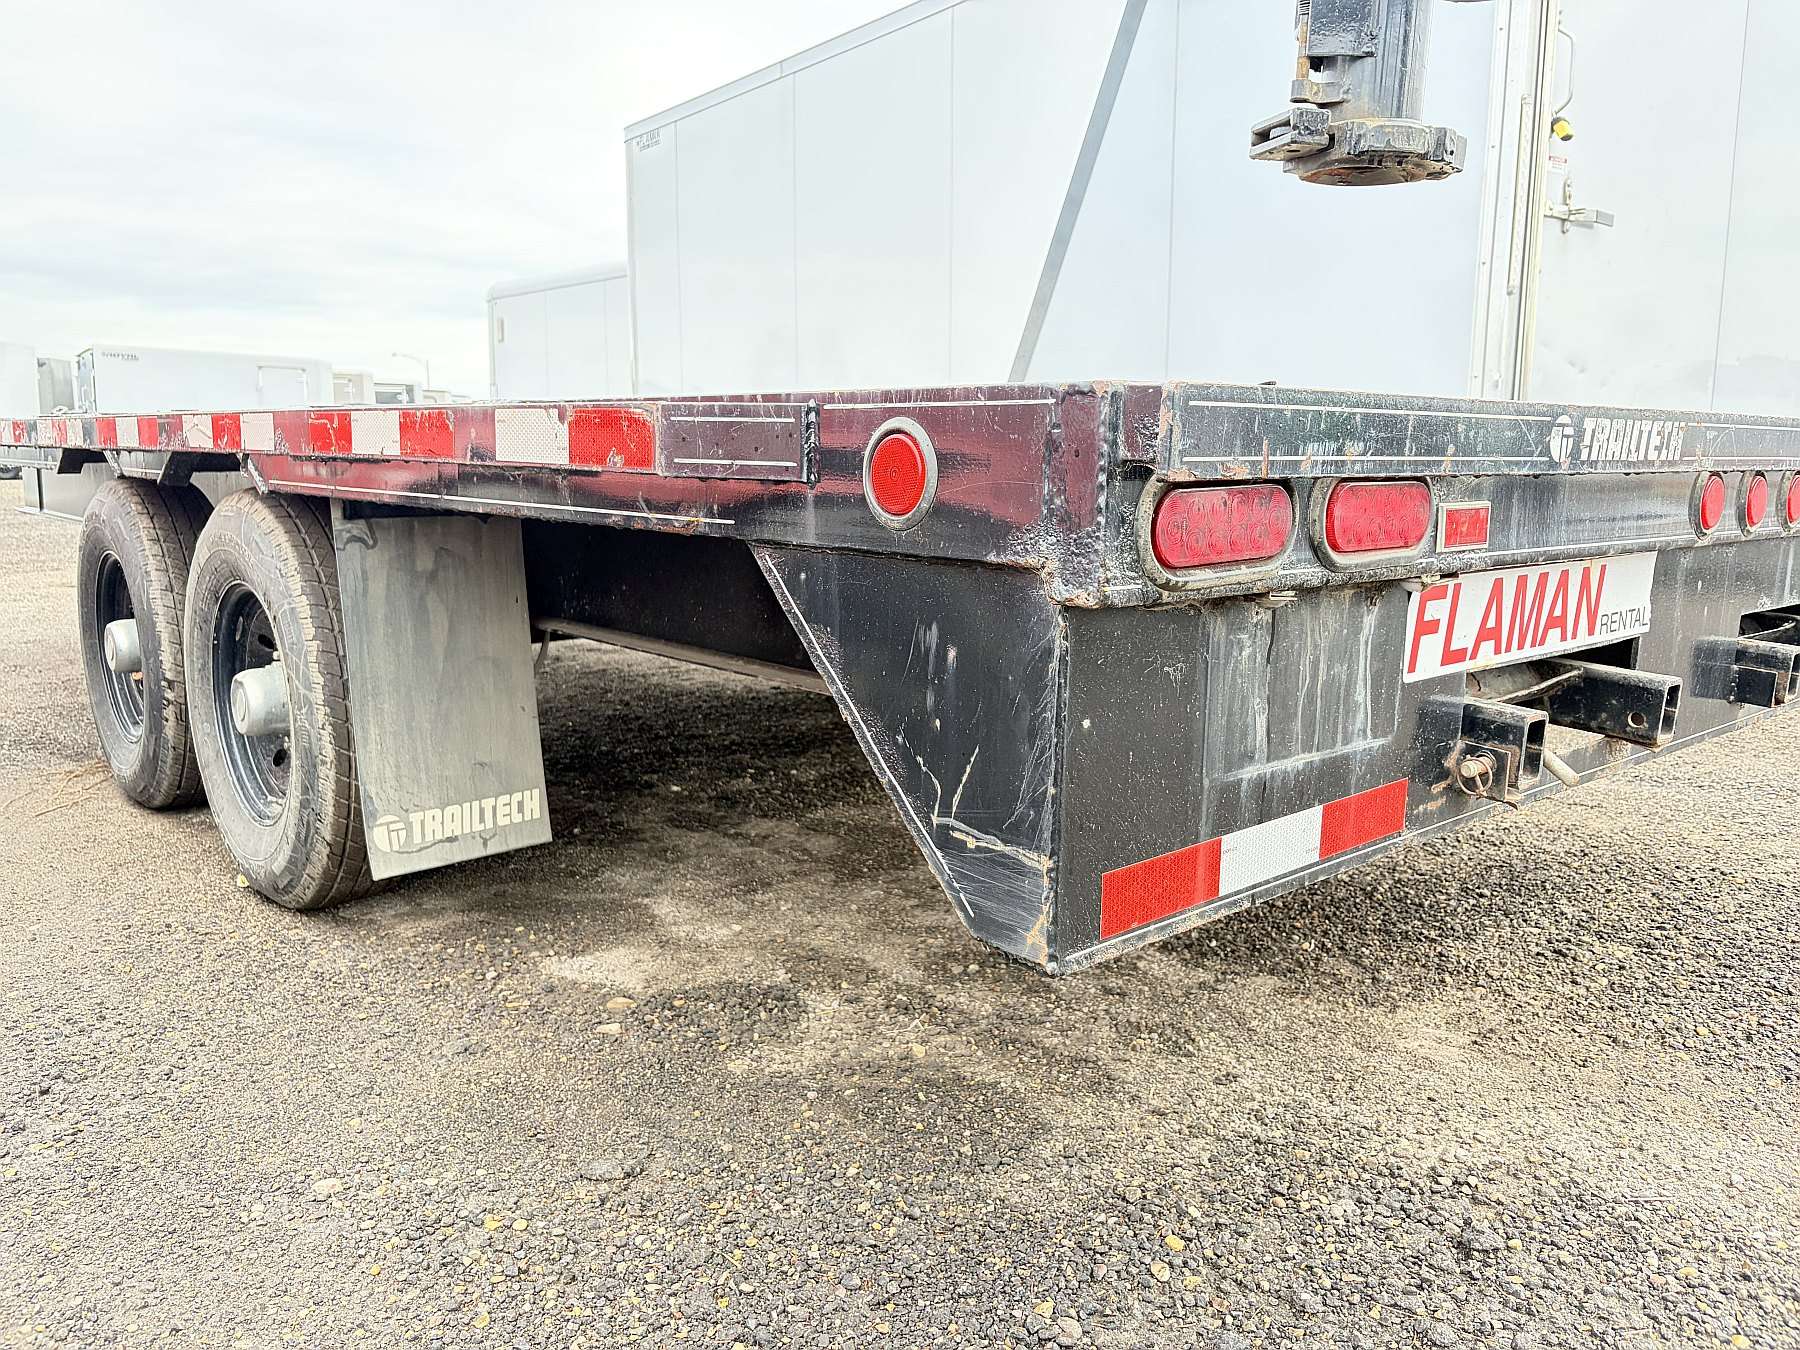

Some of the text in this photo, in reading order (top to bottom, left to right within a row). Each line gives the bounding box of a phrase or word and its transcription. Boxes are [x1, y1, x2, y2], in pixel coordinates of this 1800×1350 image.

[1579, 417, 1688, 461] TRAILTECH
[1407, 564, 1649, 673] FLAMAN RENTAL
[409, 788, 541, 844] TRAILTECH
